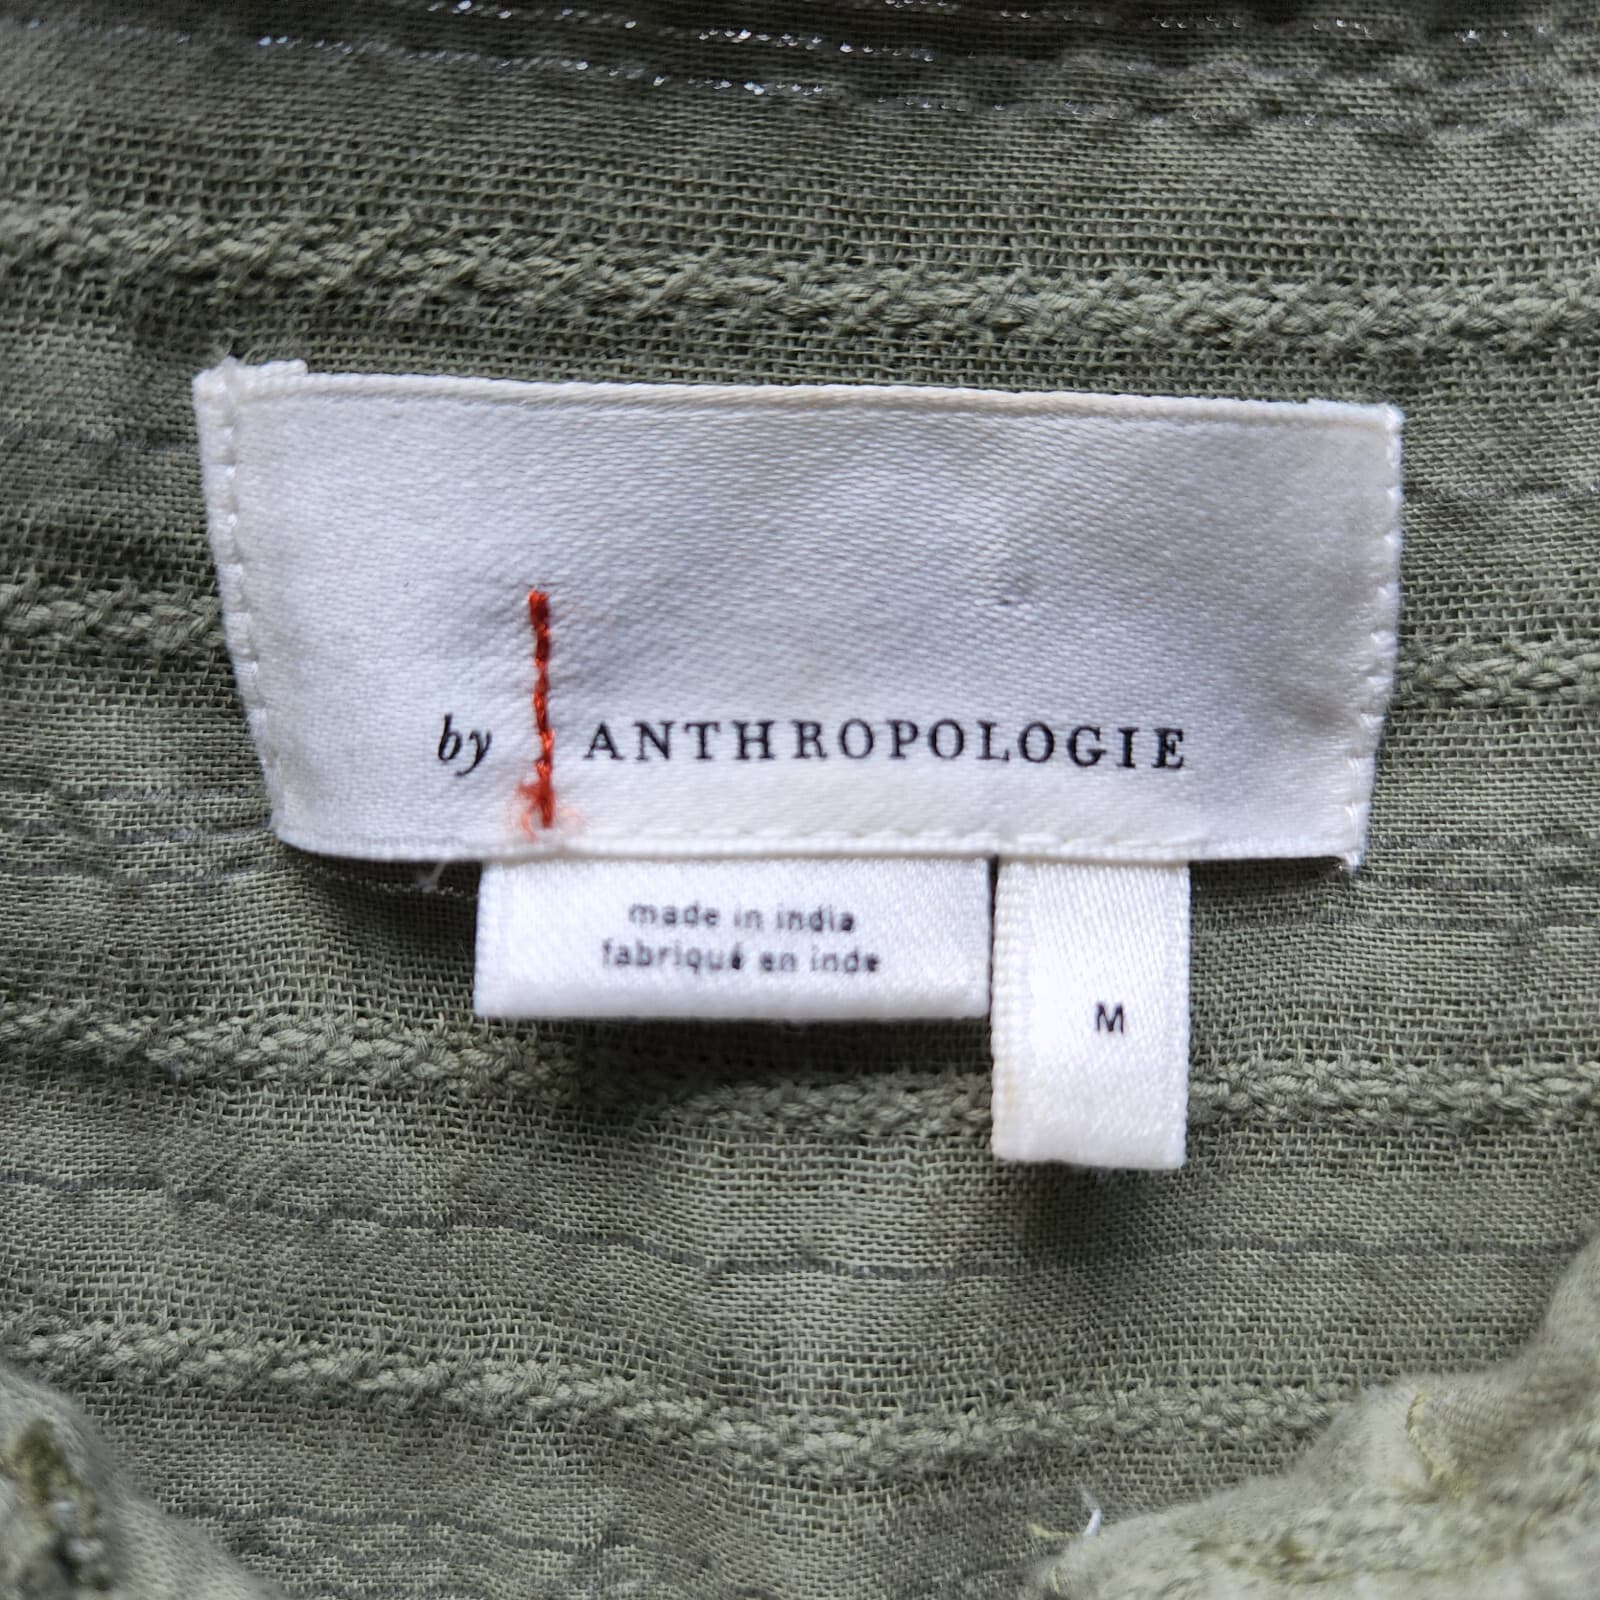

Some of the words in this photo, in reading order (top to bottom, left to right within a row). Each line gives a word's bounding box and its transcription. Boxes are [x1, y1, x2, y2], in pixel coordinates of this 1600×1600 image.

[437, 712, 493, 778] by
[583, 717, 1187, 772] ANTHROPOLOGIE
[627, 902, 720, 928] made
[733, 903, 763, 930] in
[776, 903, 856, 934] india
[601, 939, 744, 975] fabriqué
[759, 951, 798, 974] en
[809, 945, 881, 975] inde
[1095, 1001, 1126, 1036] M
